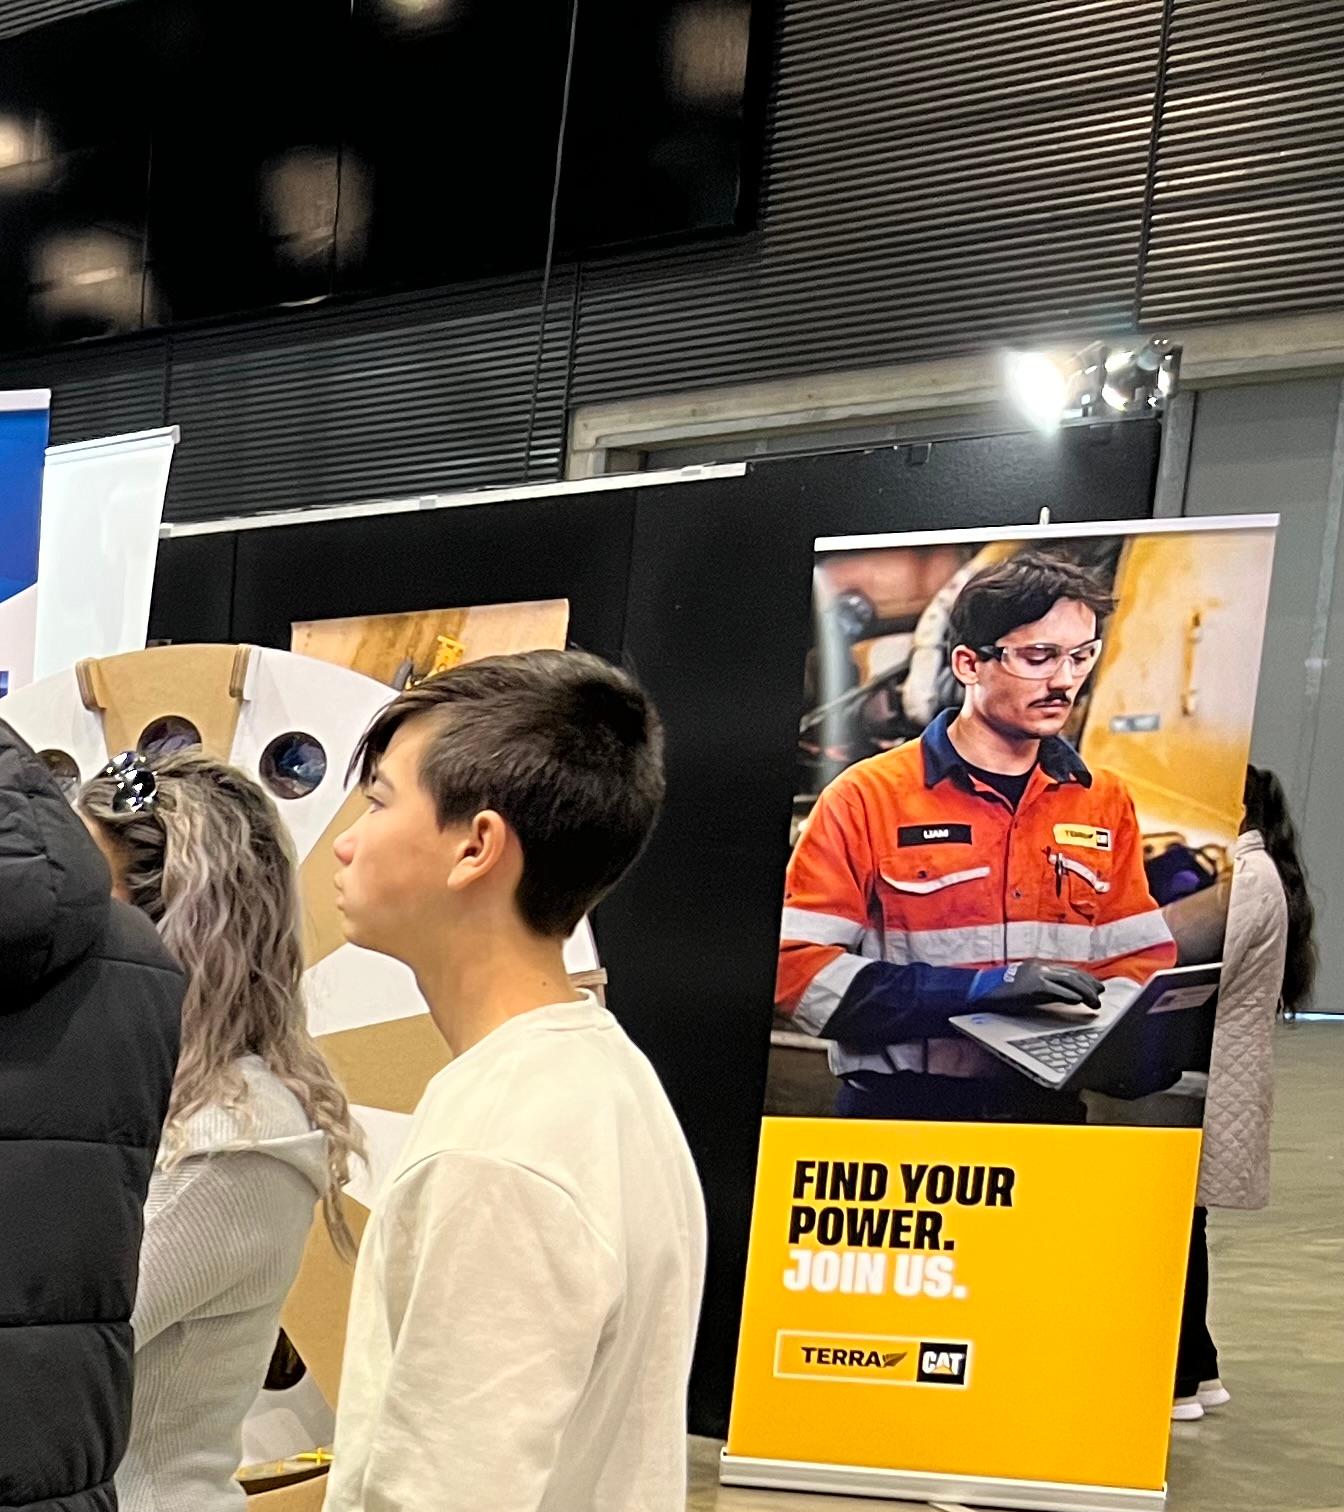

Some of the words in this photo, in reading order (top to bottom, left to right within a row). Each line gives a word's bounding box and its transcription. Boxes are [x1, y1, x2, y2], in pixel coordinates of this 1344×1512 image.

[792, 1160, 888, 1202] FIND
[900, 1164, 1015, 1208] YOUR
[787, 1206, 955, 1251] POWER.
[782, 1249, 887, 1295] JOIN
[892, 1254, 967, 1299] US.
[800, 1346, 882, 1368] TERRA
[921, 1349, 965, 1377] CAT
